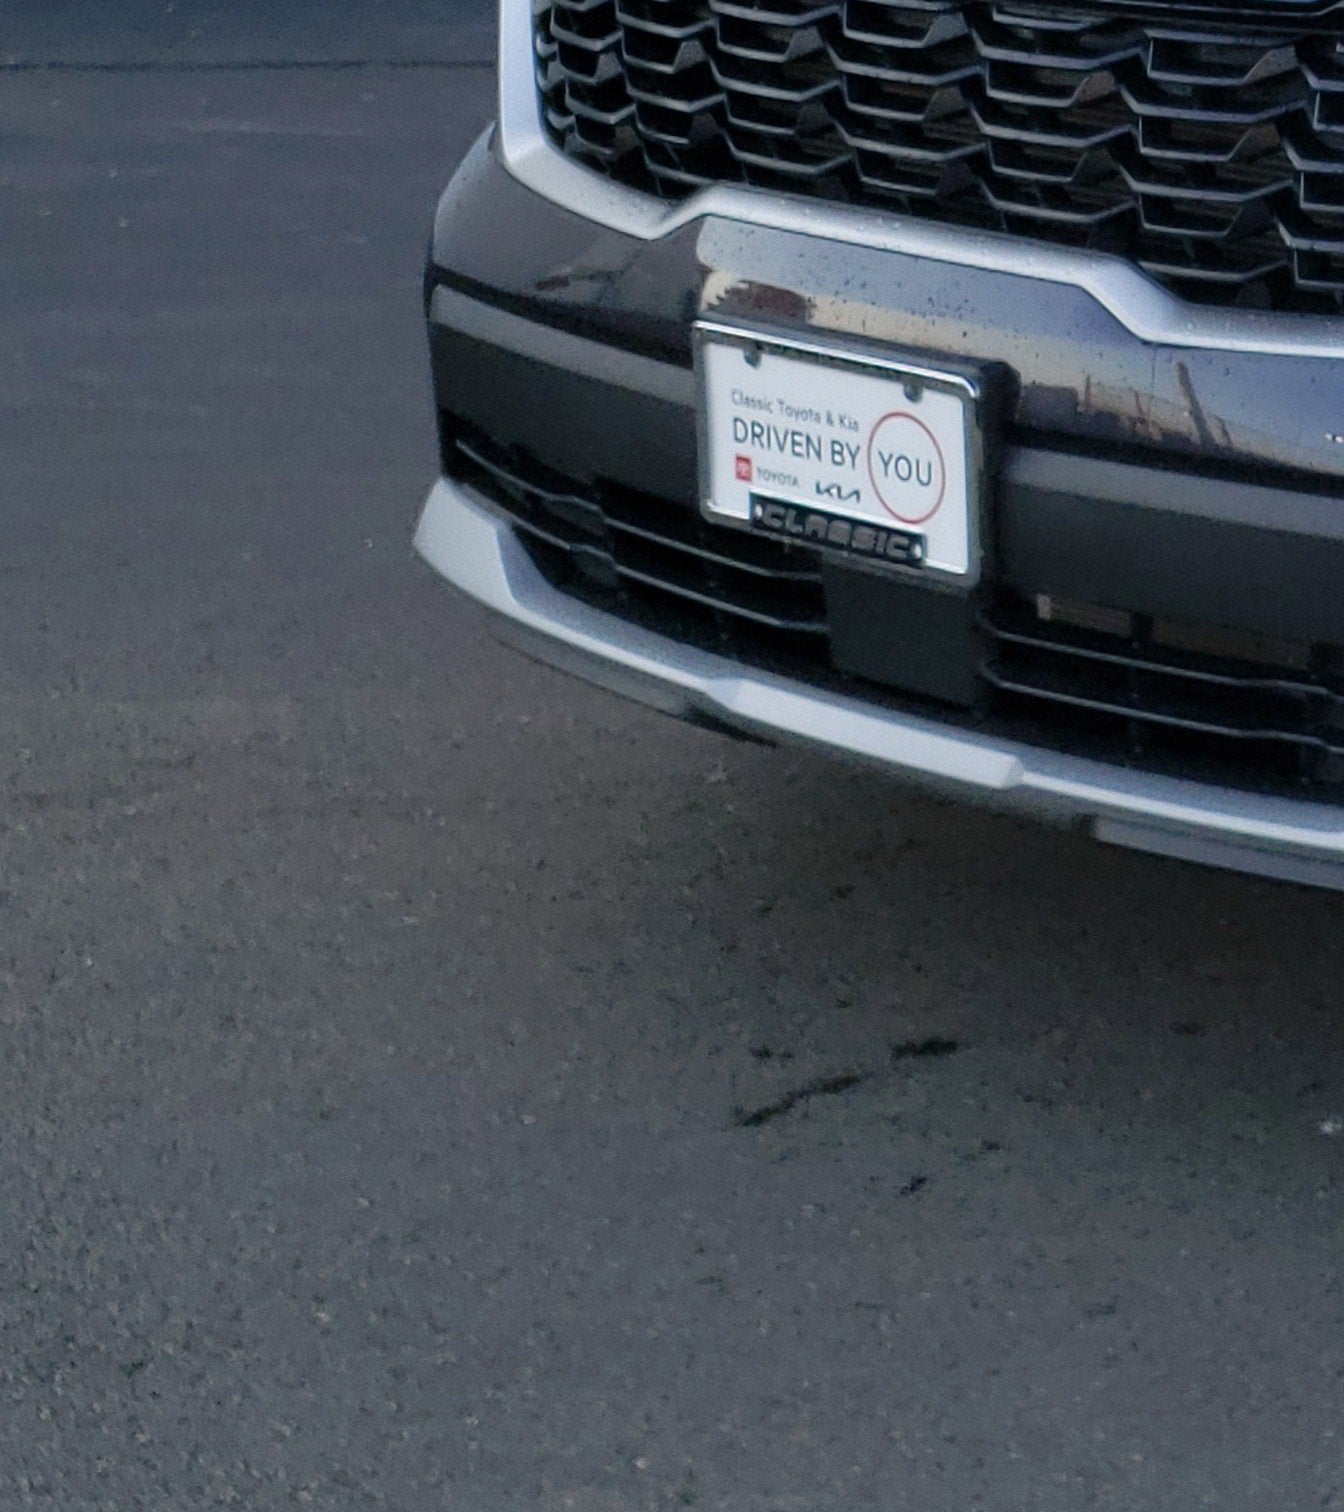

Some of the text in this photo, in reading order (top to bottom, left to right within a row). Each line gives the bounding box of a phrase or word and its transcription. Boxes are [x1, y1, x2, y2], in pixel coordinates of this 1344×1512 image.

[731, 389, 860, 432] Classic Toyota & Kia
[733, 417, 933, 486] DRIVEN BY YOU
[756, 466, 800, 488] TOYOTA
[761, 503, 911, 560] CLASSIC
